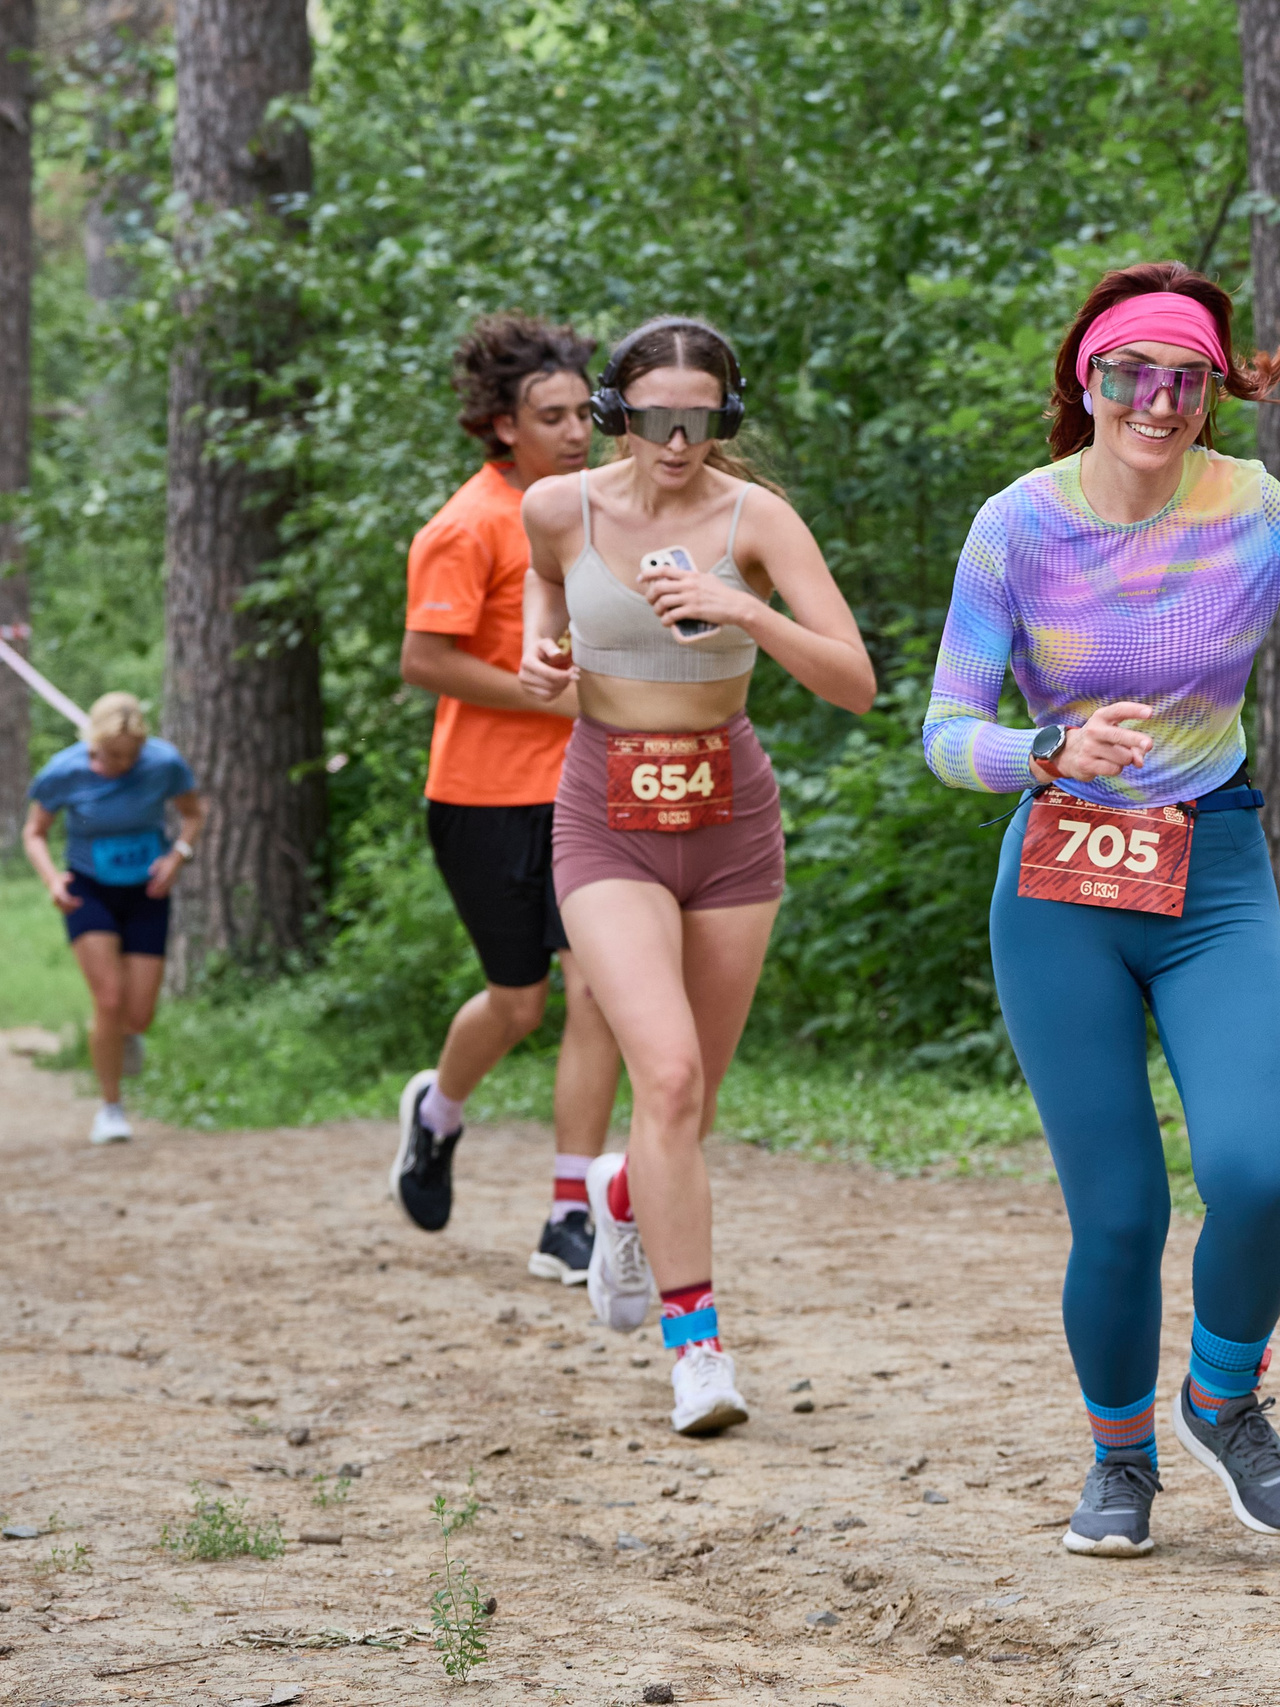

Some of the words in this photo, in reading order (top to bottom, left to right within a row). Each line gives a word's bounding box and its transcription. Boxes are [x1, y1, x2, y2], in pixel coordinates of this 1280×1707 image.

[631, 761, 715, 801] 654
[1055, 819, 1160, 874] 705
[1080, 880, 1093, 896] 6
[1093, 883, 1119, 899] KM
